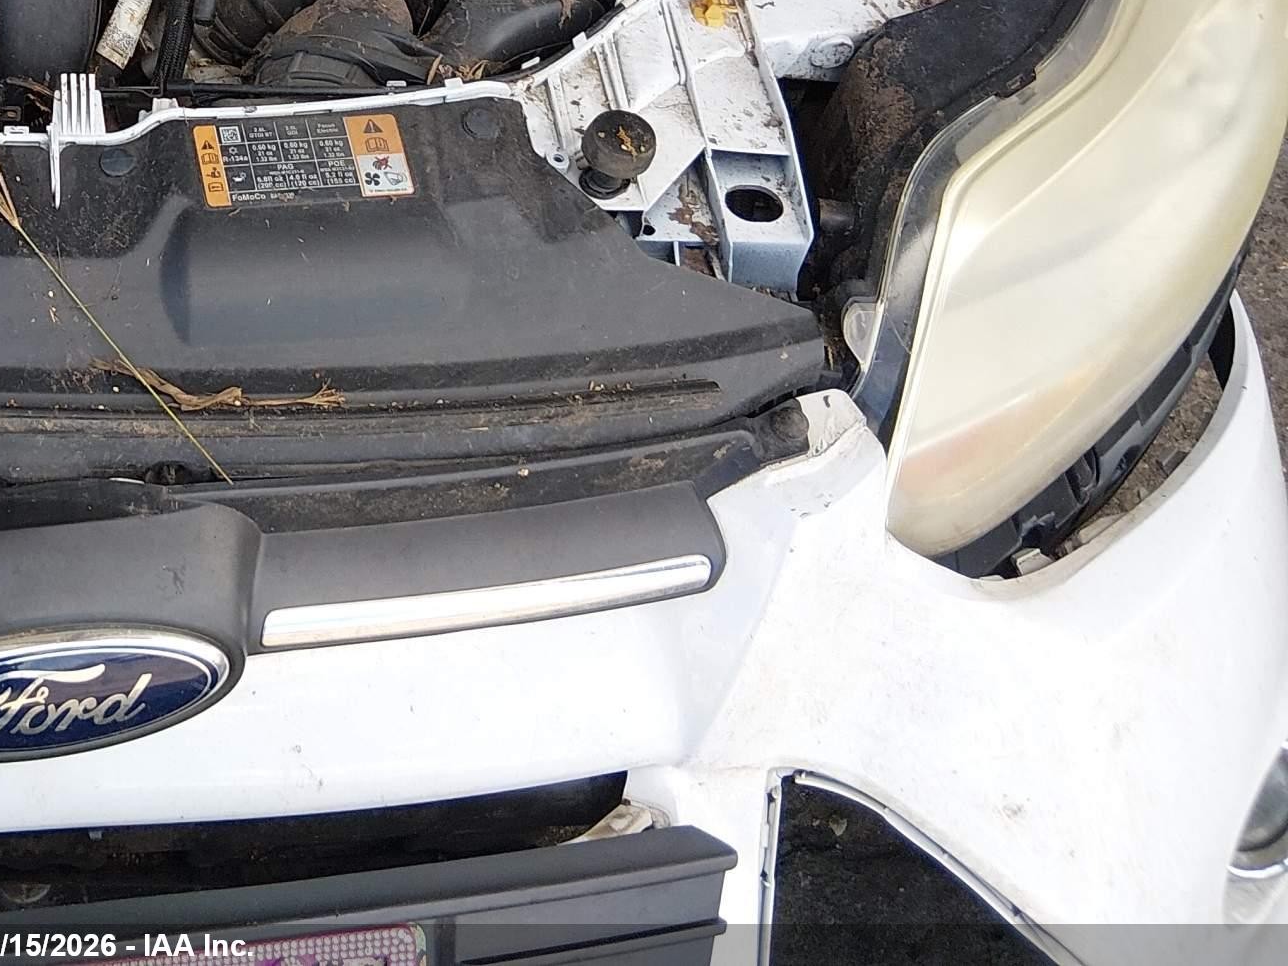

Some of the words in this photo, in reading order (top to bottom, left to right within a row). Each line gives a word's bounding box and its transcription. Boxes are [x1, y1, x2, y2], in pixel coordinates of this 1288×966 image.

[299, 141, 309, 149] kg
[319, 139, 333, 147] 0.60
[334, 139, 344, 147] kg
[267, 144, 277, 152] kg
[343, 177, 356, 185] cc)
[231, 192, 266, 201] FoMoCo
